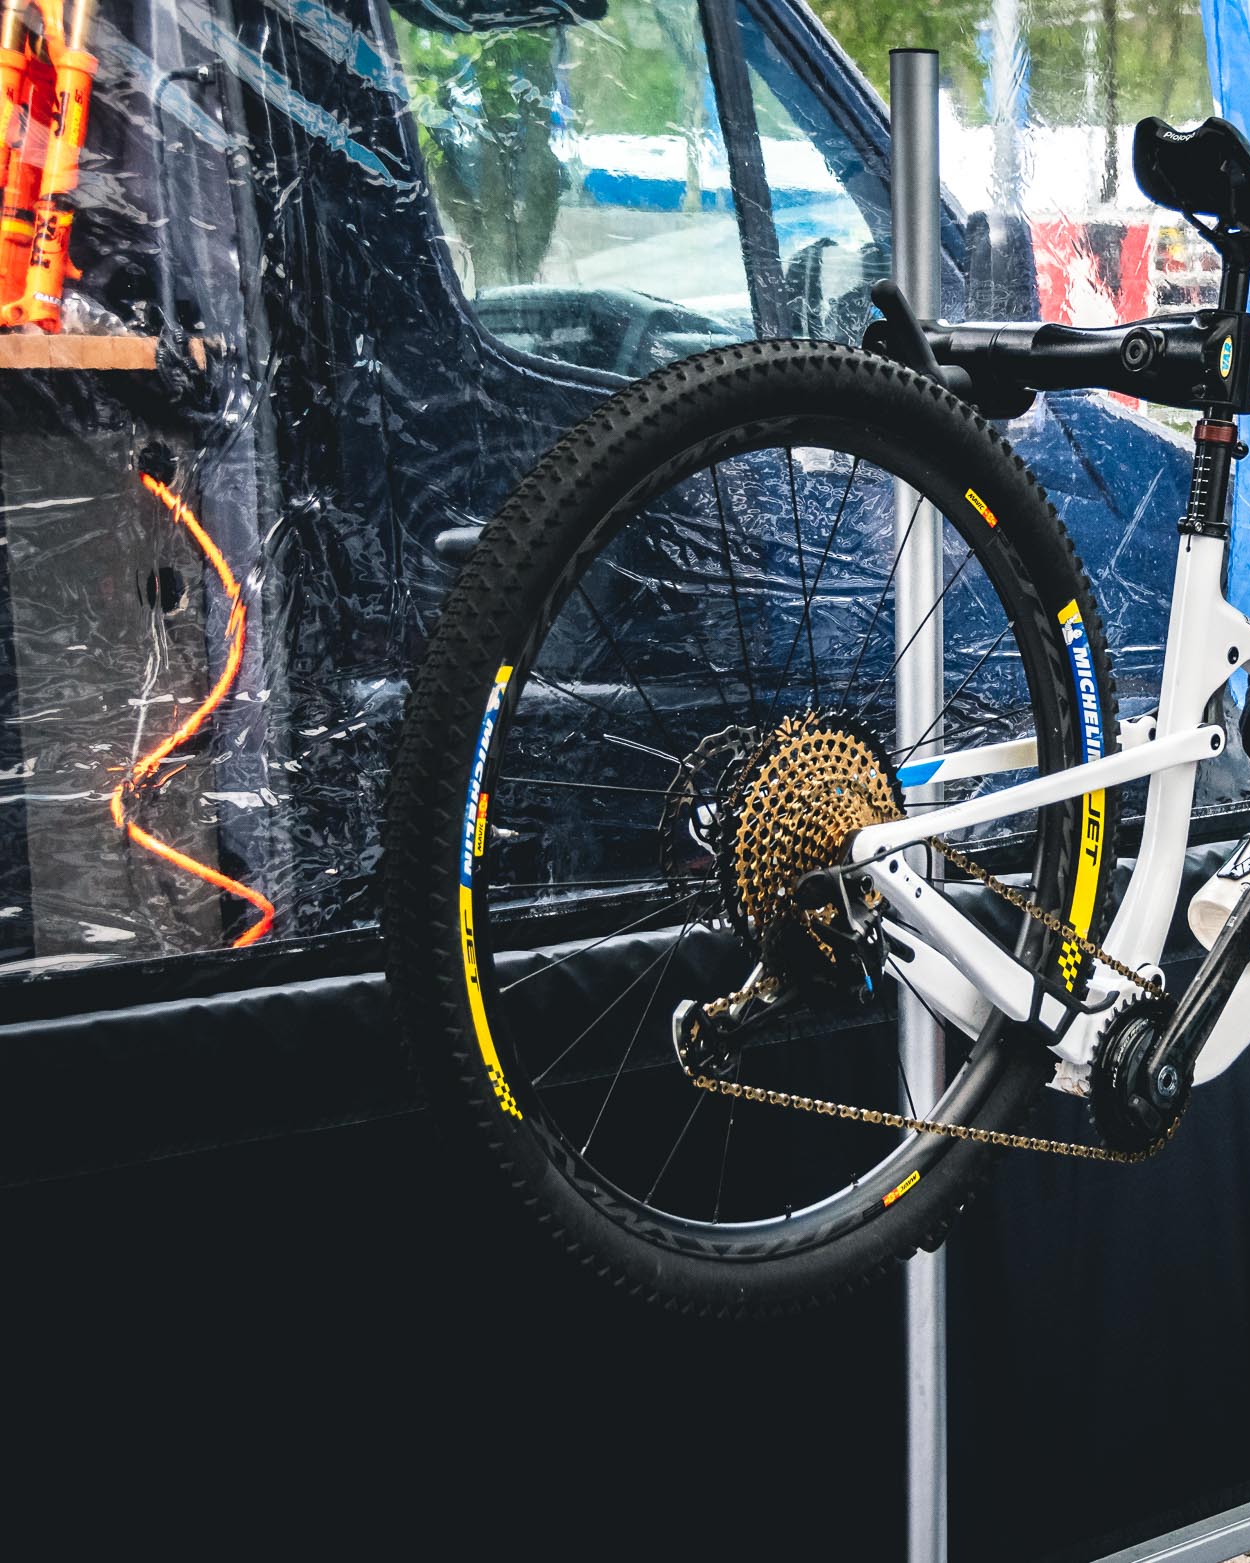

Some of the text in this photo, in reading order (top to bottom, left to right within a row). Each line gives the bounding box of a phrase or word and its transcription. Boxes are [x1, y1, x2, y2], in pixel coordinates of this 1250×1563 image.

[464, 717, 494, 877] MICHELIN
[1086, 793, 1101, 866] JET
[476, 823, 484, 852] MAVIC
[464, 909, 480, 992] JET
